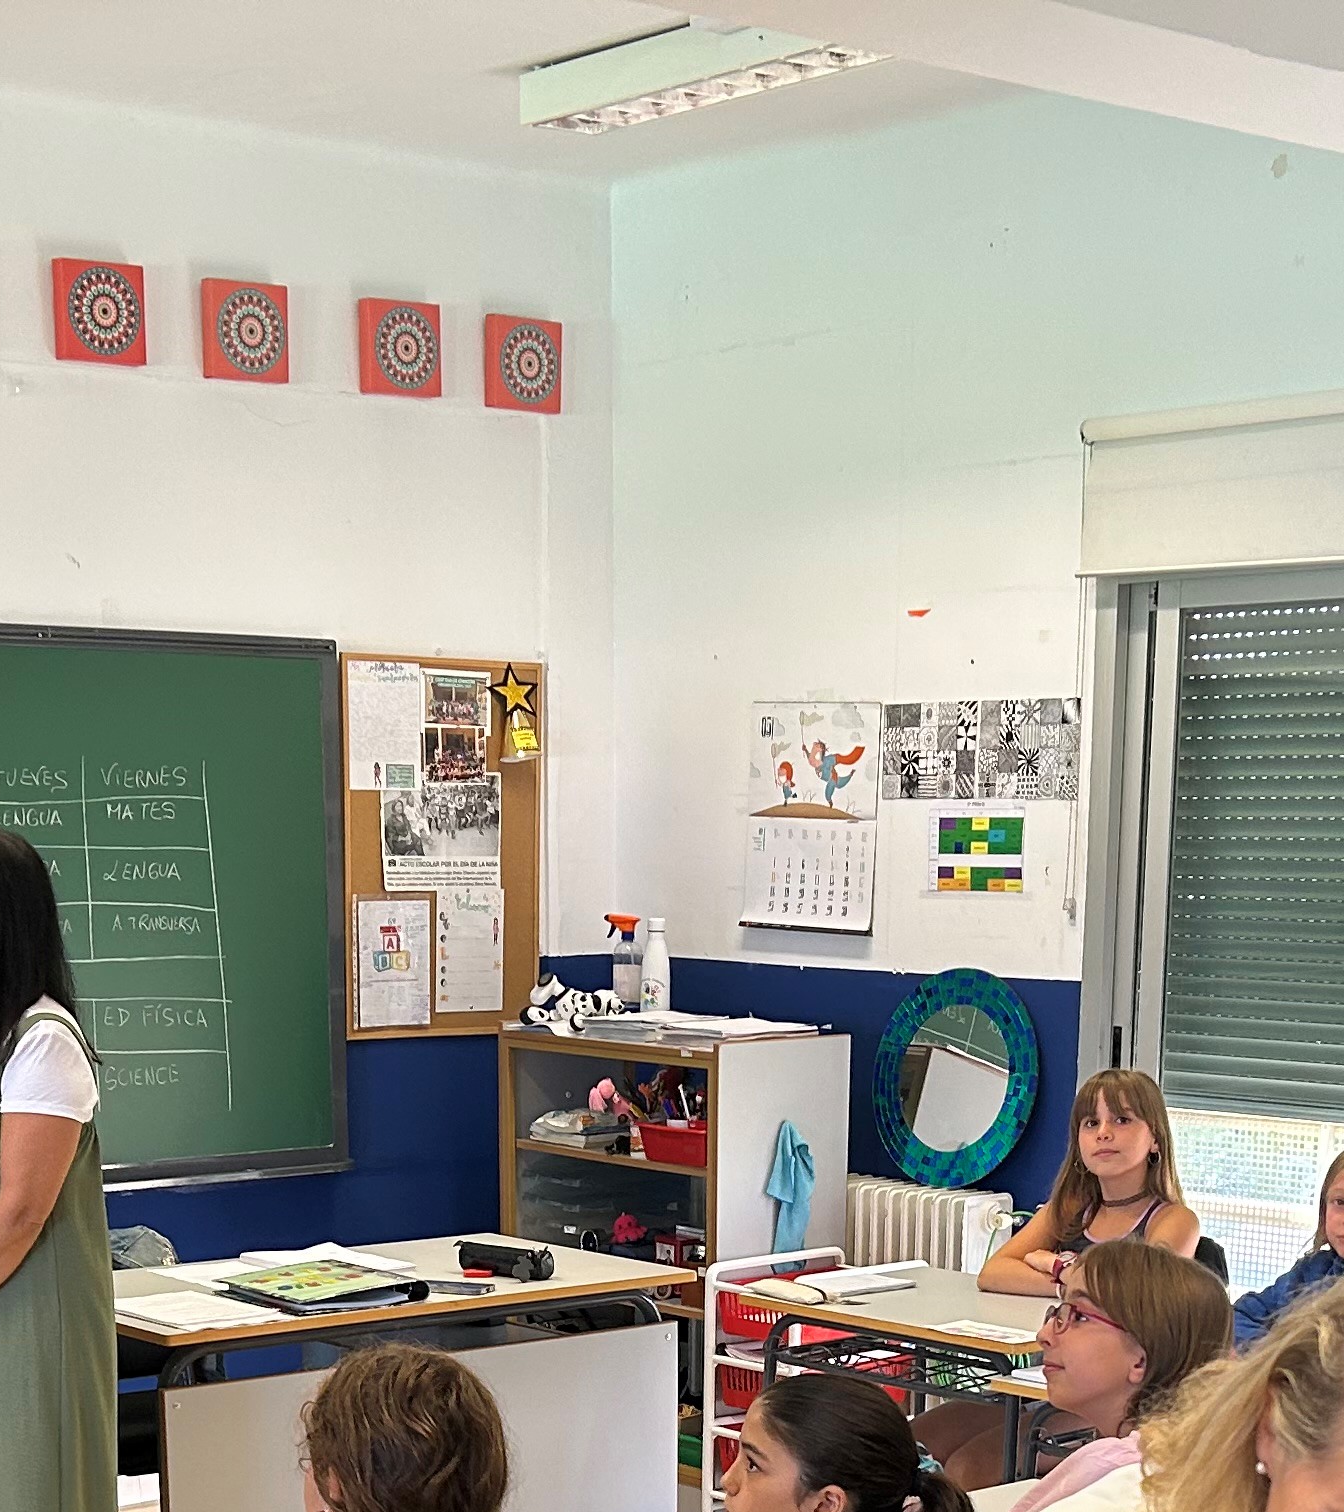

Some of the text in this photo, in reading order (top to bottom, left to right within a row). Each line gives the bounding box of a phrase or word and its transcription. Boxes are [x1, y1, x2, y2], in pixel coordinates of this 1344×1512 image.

[100, 762, 187, 790] VIERNES
[103, 861, 181, 882] LENGUA
[104, 1006, 130, 1027] ED
[143, 1003, 208, 1028] FÍSICA
[105, 1064, 180, 1091] SCIENCE
